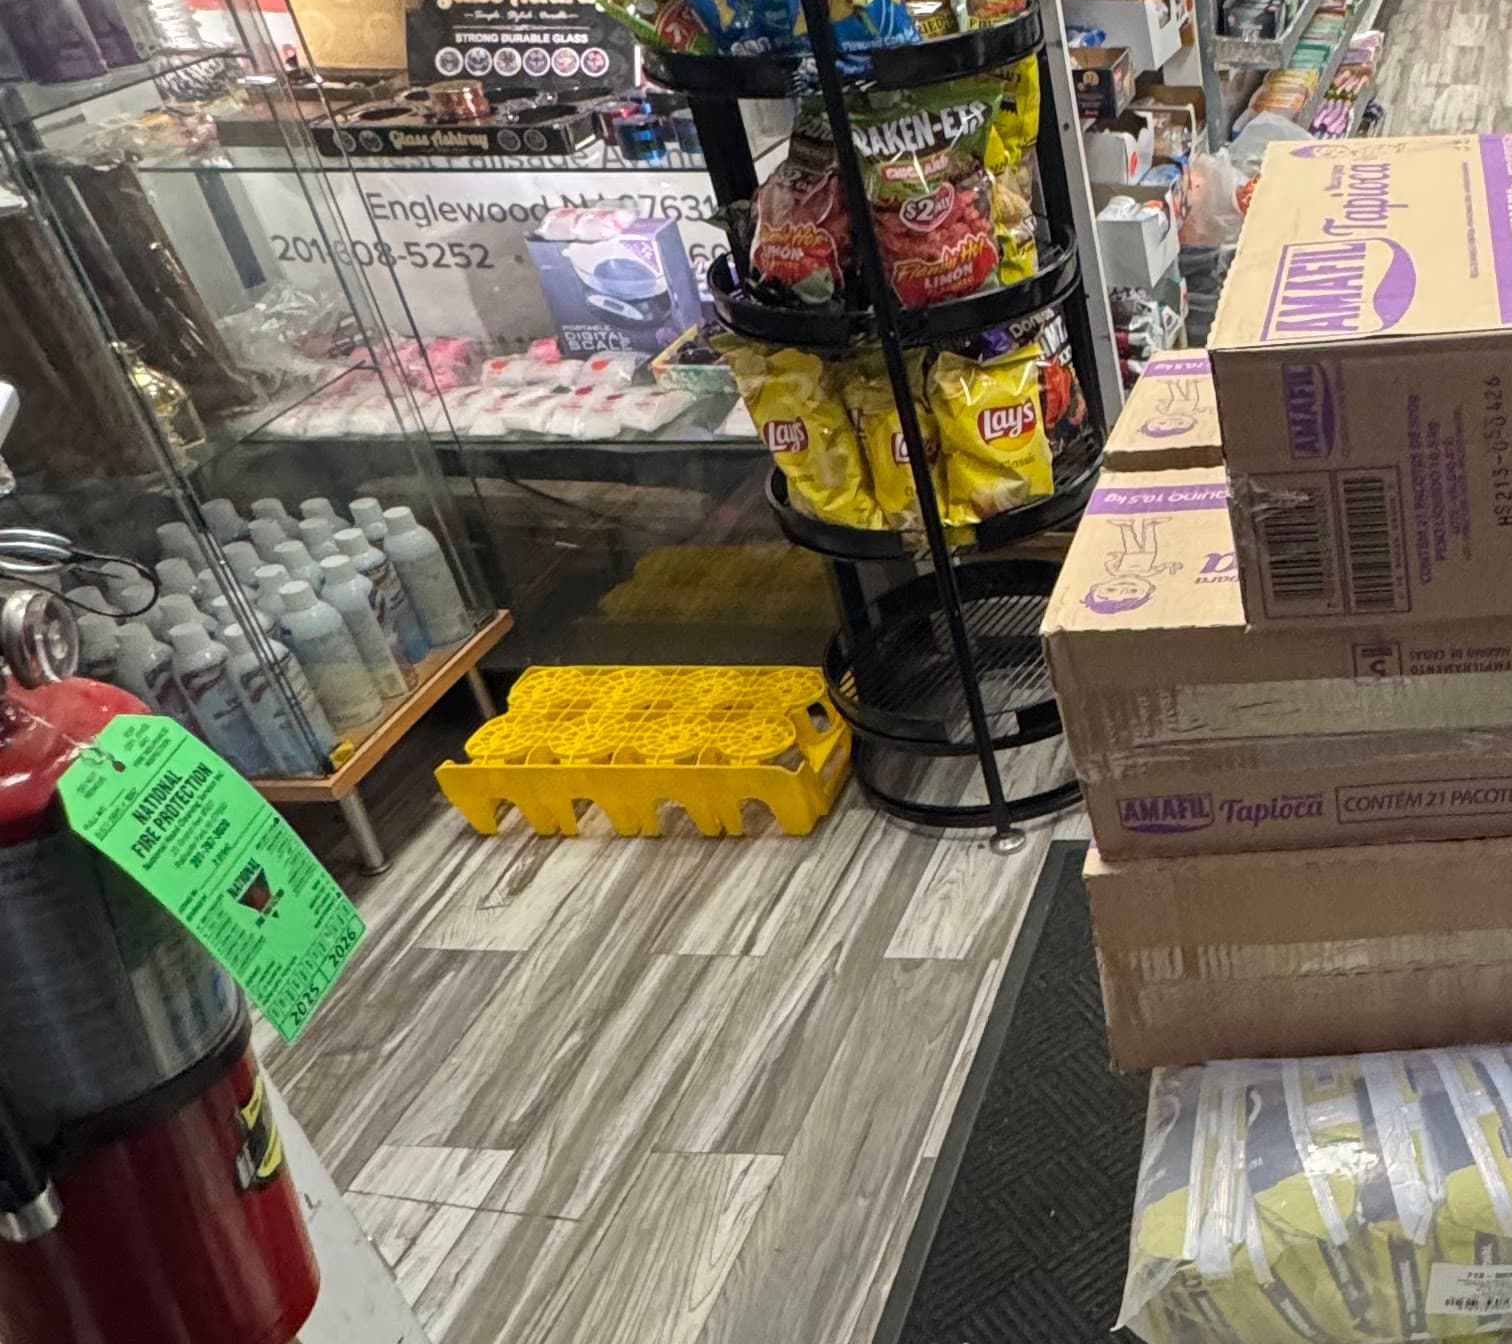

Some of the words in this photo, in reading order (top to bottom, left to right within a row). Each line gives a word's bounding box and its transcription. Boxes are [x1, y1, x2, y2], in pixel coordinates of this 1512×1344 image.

[455, 33, 499, 44] STRONG
[500, 33, 551, 44] DURABLE
[552, 33, 589, 44] GLASS
[389, 130, 431, 149] Glass
[433, 130, 489, 149] Ashtray
[364, 192, 550, 227] Englewood
[903, 200, 934, 223] $2
[1321, 163, 1408, 236] Tapioca
[1276, 241, 1366, 333] AMAFIL
[564, 331, 627, 342] DIGITAL
[567, 340, 633, 351] SCALE
[983, 399, 1035, 440] Lay's
[1286, 364, 1320, 455] AMAFIL
[130, 826, 161, 859] FIRE
[152, 761, 213, 833] PROTECTION
[131, 769, 183, 826] NATIONAL
[1123, 793, 1210, 823] AMAFIL
[1219, 797, 1323, 828] Tapioca
[1426, 792, 1447, 807] 21
[285, 981, 326, 1027] 2025
[323, 925, 361, 969] 2026
